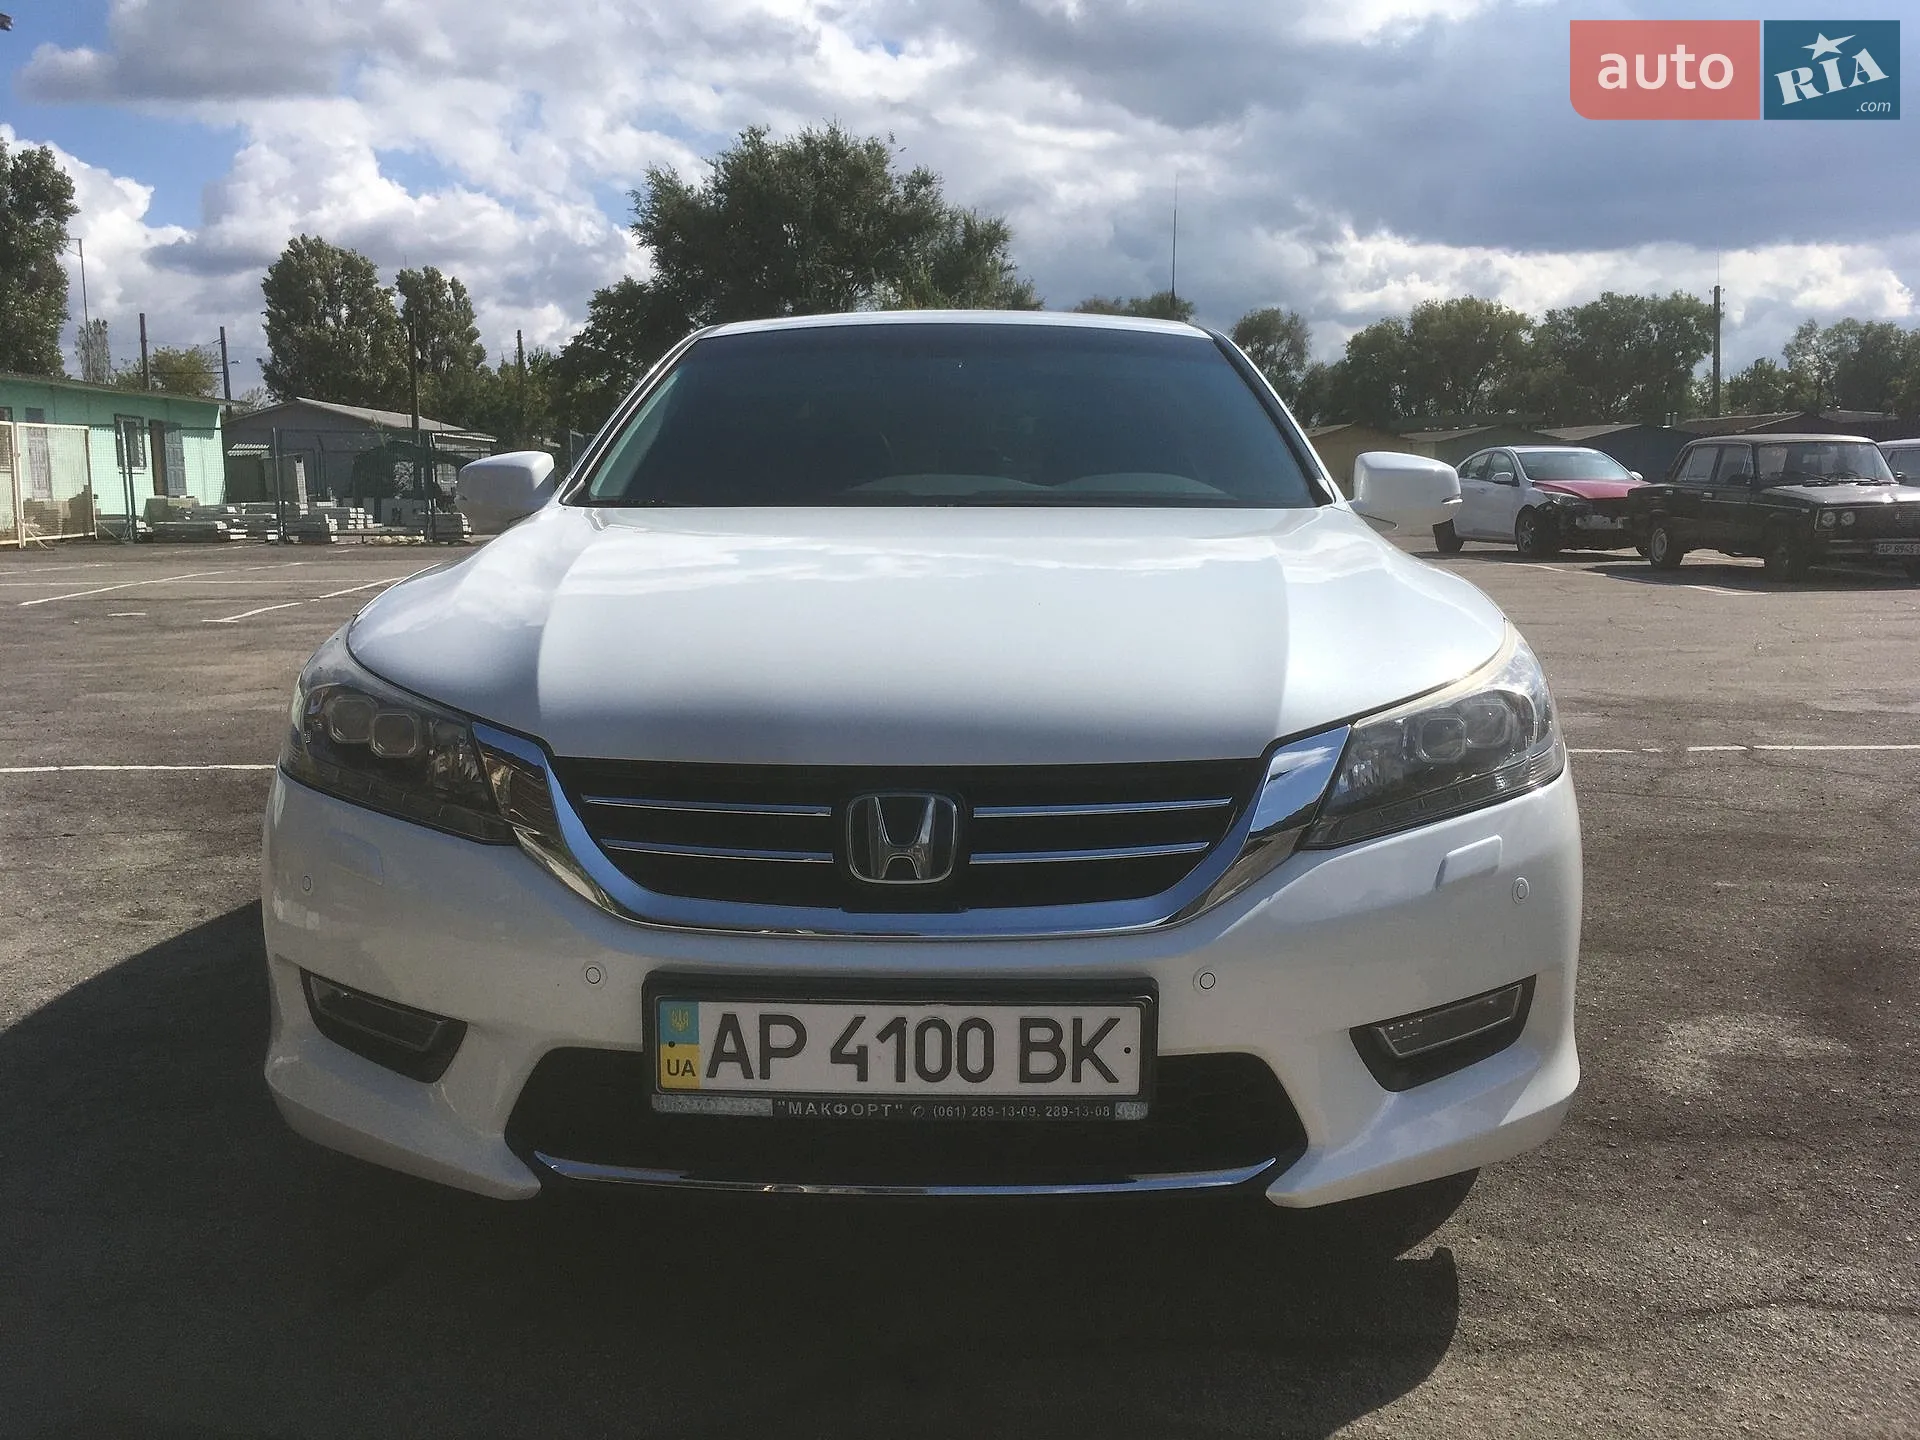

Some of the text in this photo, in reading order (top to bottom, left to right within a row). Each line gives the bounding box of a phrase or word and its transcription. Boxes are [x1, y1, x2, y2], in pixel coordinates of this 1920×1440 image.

[705, 1013, 1121, 1084] AP 4100 BK
[666, 1058, 697, 1077] UA
[932, 1105, 966, 1119] (061)
